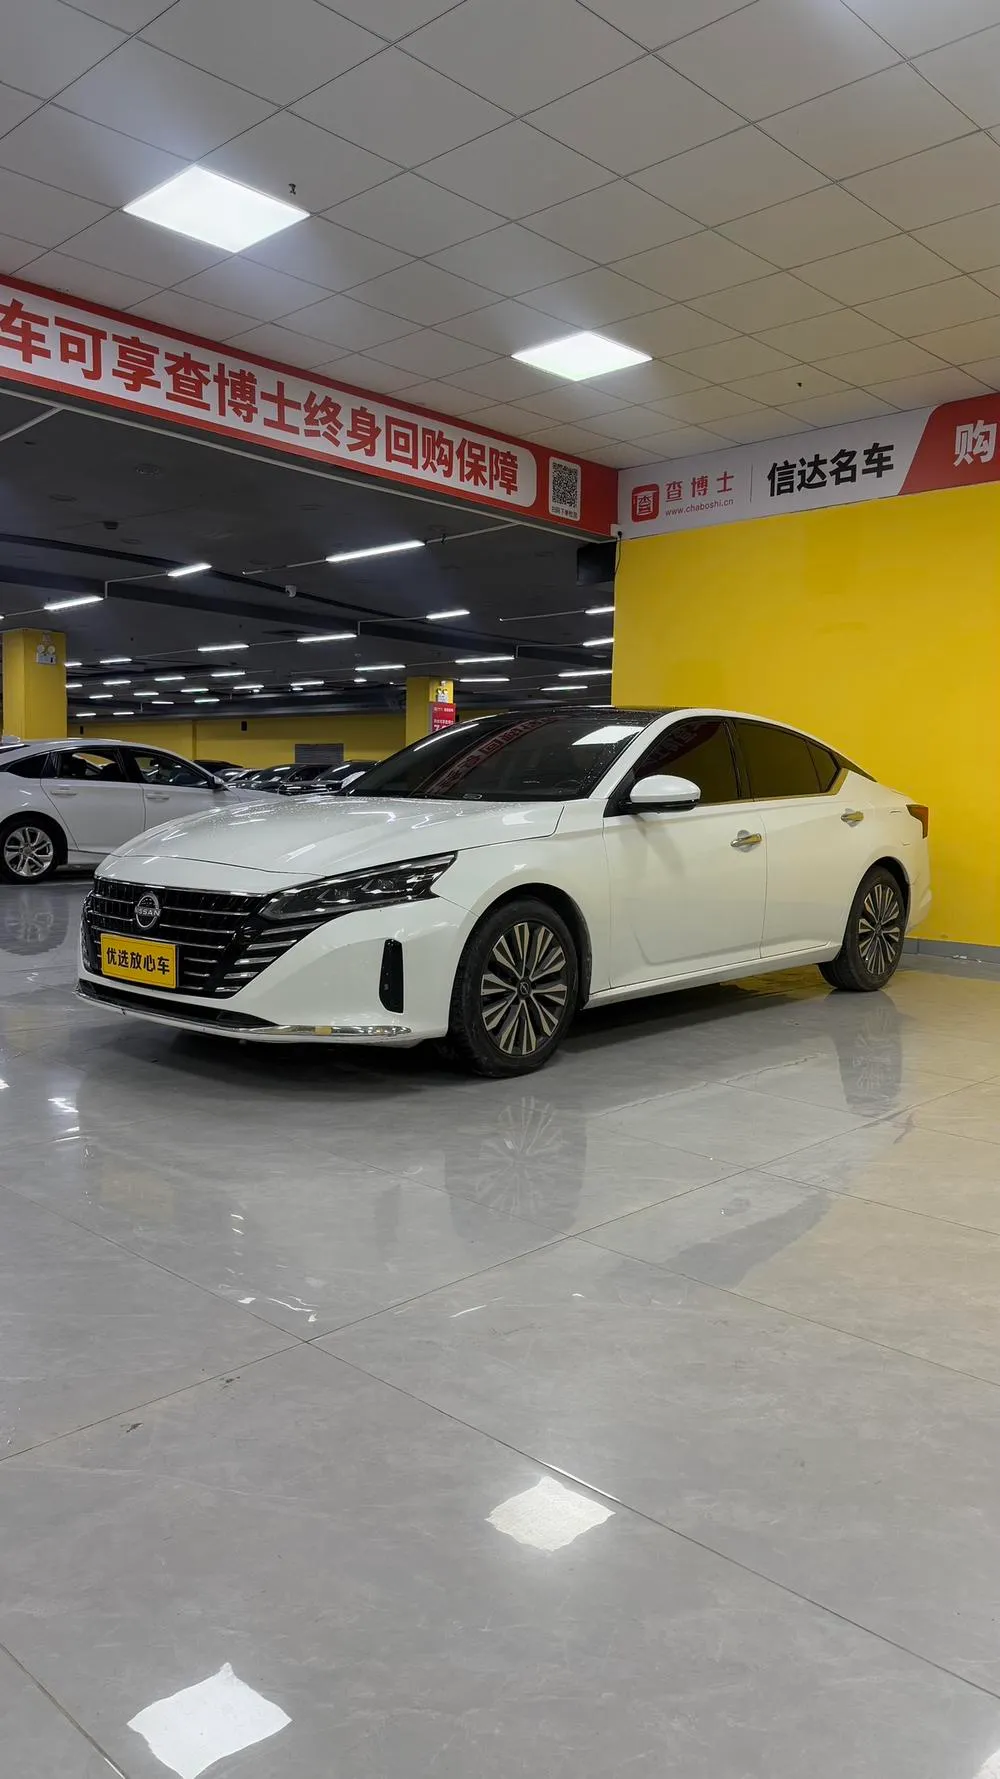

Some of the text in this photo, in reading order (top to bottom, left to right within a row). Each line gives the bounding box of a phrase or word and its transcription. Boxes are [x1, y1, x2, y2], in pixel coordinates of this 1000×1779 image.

[0, 298, 518, 496] 车可享查博士终身回购保障
[952, 419, 997, 467] 购
[767, 442, 895, 497] 信达名车
[665, 470, 735, 502] 查博士
[665, 498, 734, 517] www.chaboshi.cn
[135, 905, 161, 917] SSAN
[106, 946, 170, 976] 优选放心车
